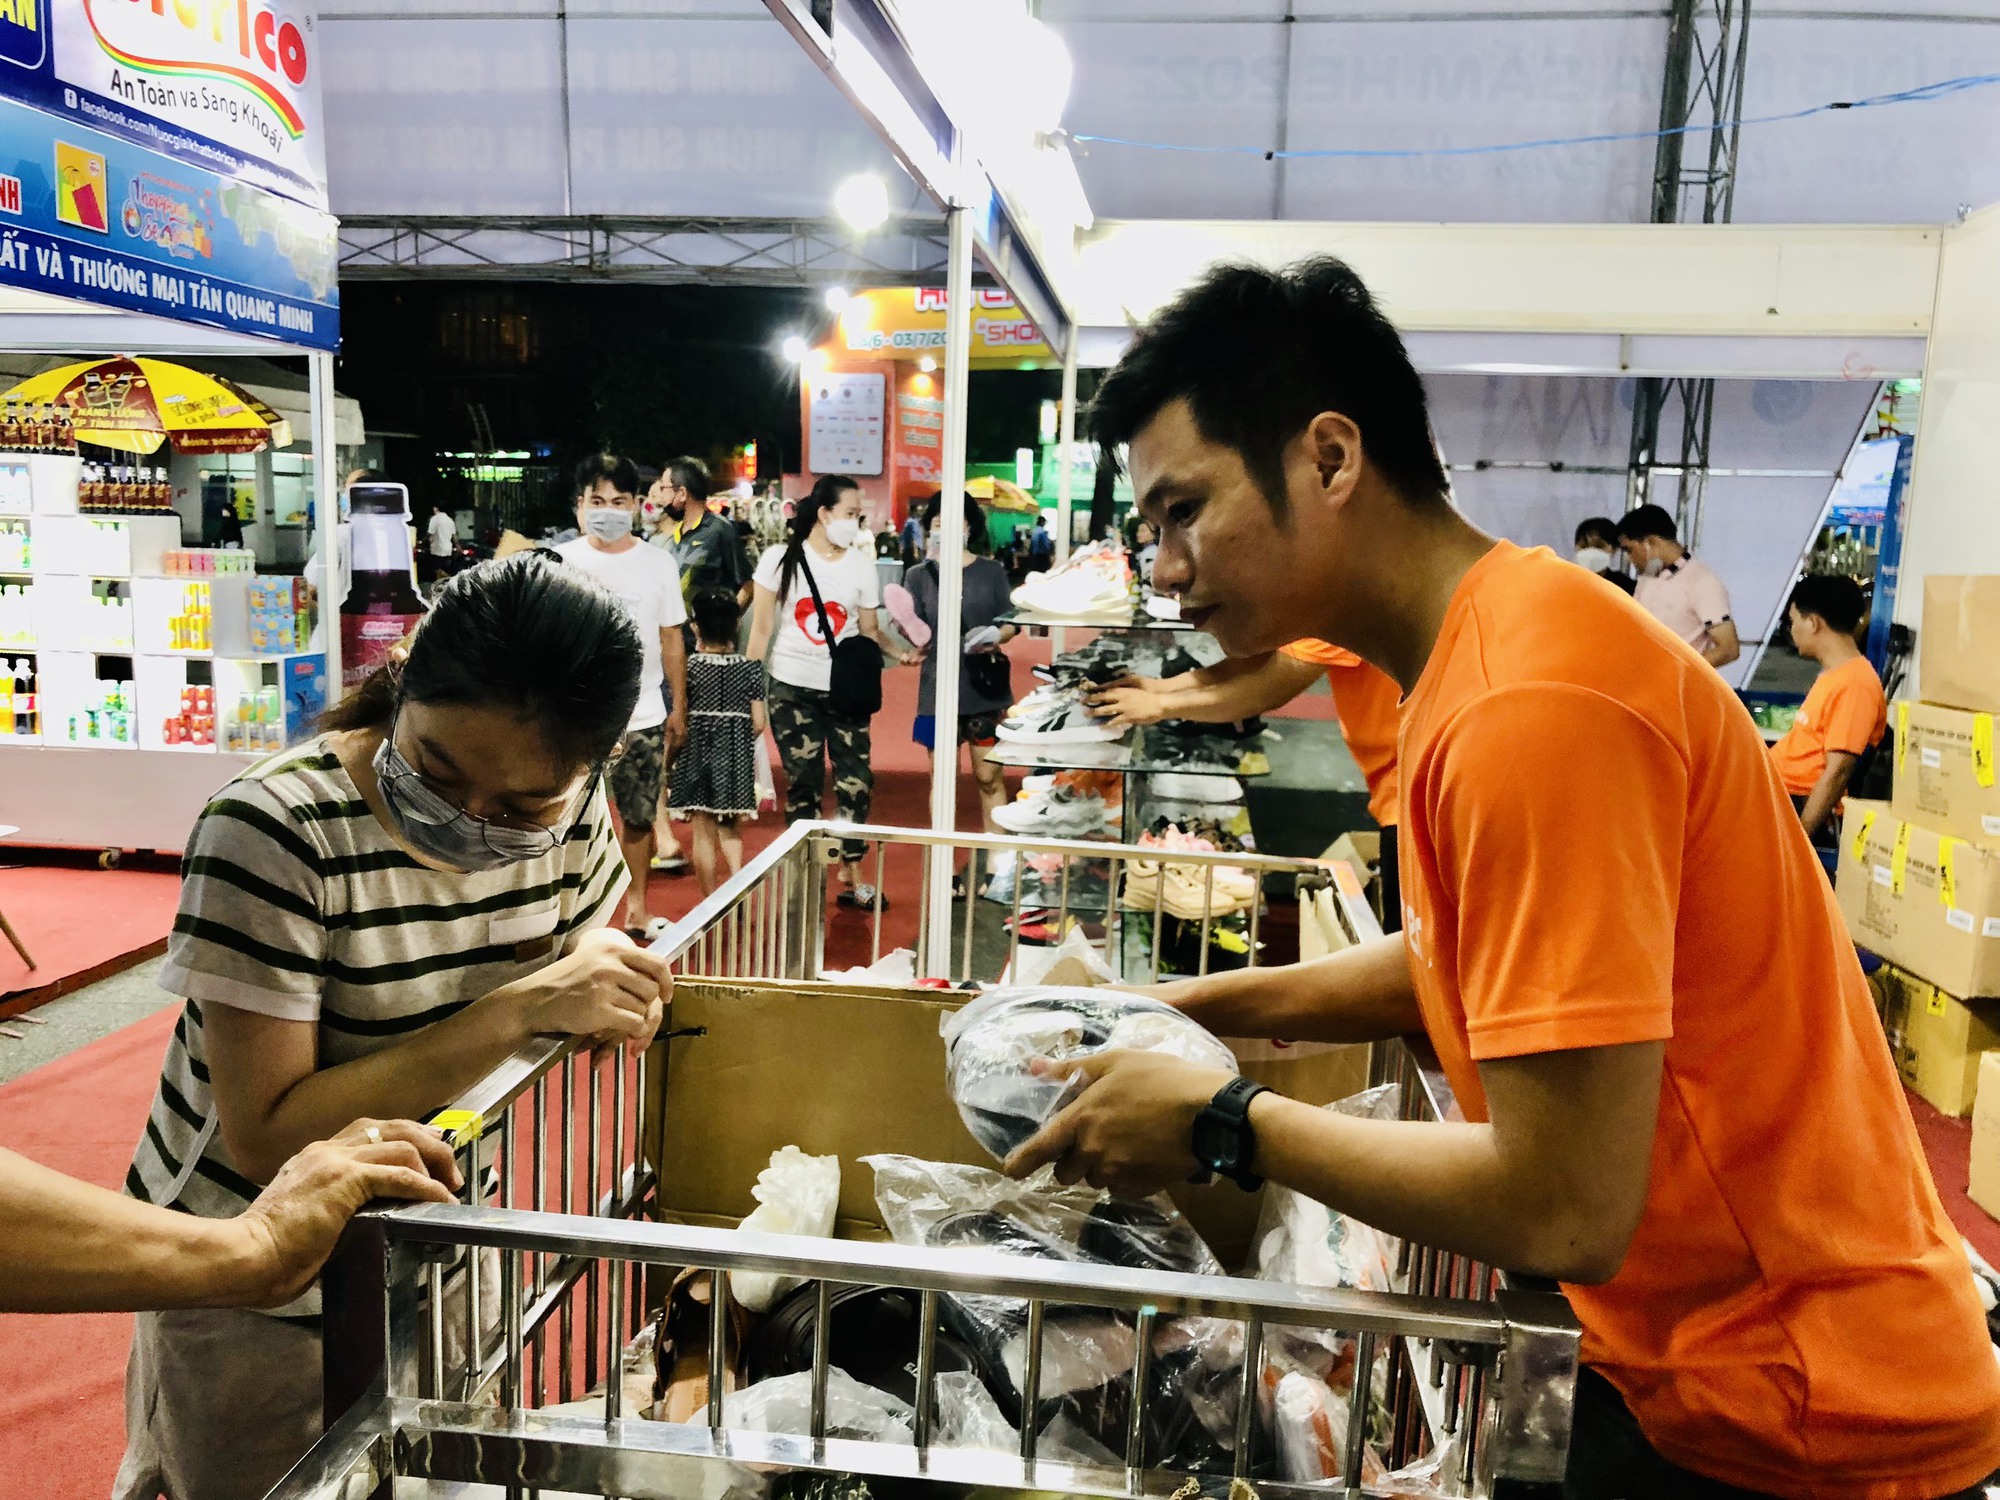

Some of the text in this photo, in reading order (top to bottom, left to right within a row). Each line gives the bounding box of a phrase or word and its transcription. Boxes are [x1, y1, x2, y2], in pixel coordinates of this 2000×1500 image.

[111, 69, 135, 100] An
[137, 78, 177, 107] Toàn
[242, 101, 283, 153] Khoái
[35, 242, 64, 280] VÀ
[69, 255, 148, 297] THƯƠNG
[152, 273, 185, 308] MẠI
[189, 278, 222, 313] TÂN
[226, 291, 276, 325] QUANG
[279, 303, 314, 333] MINH
